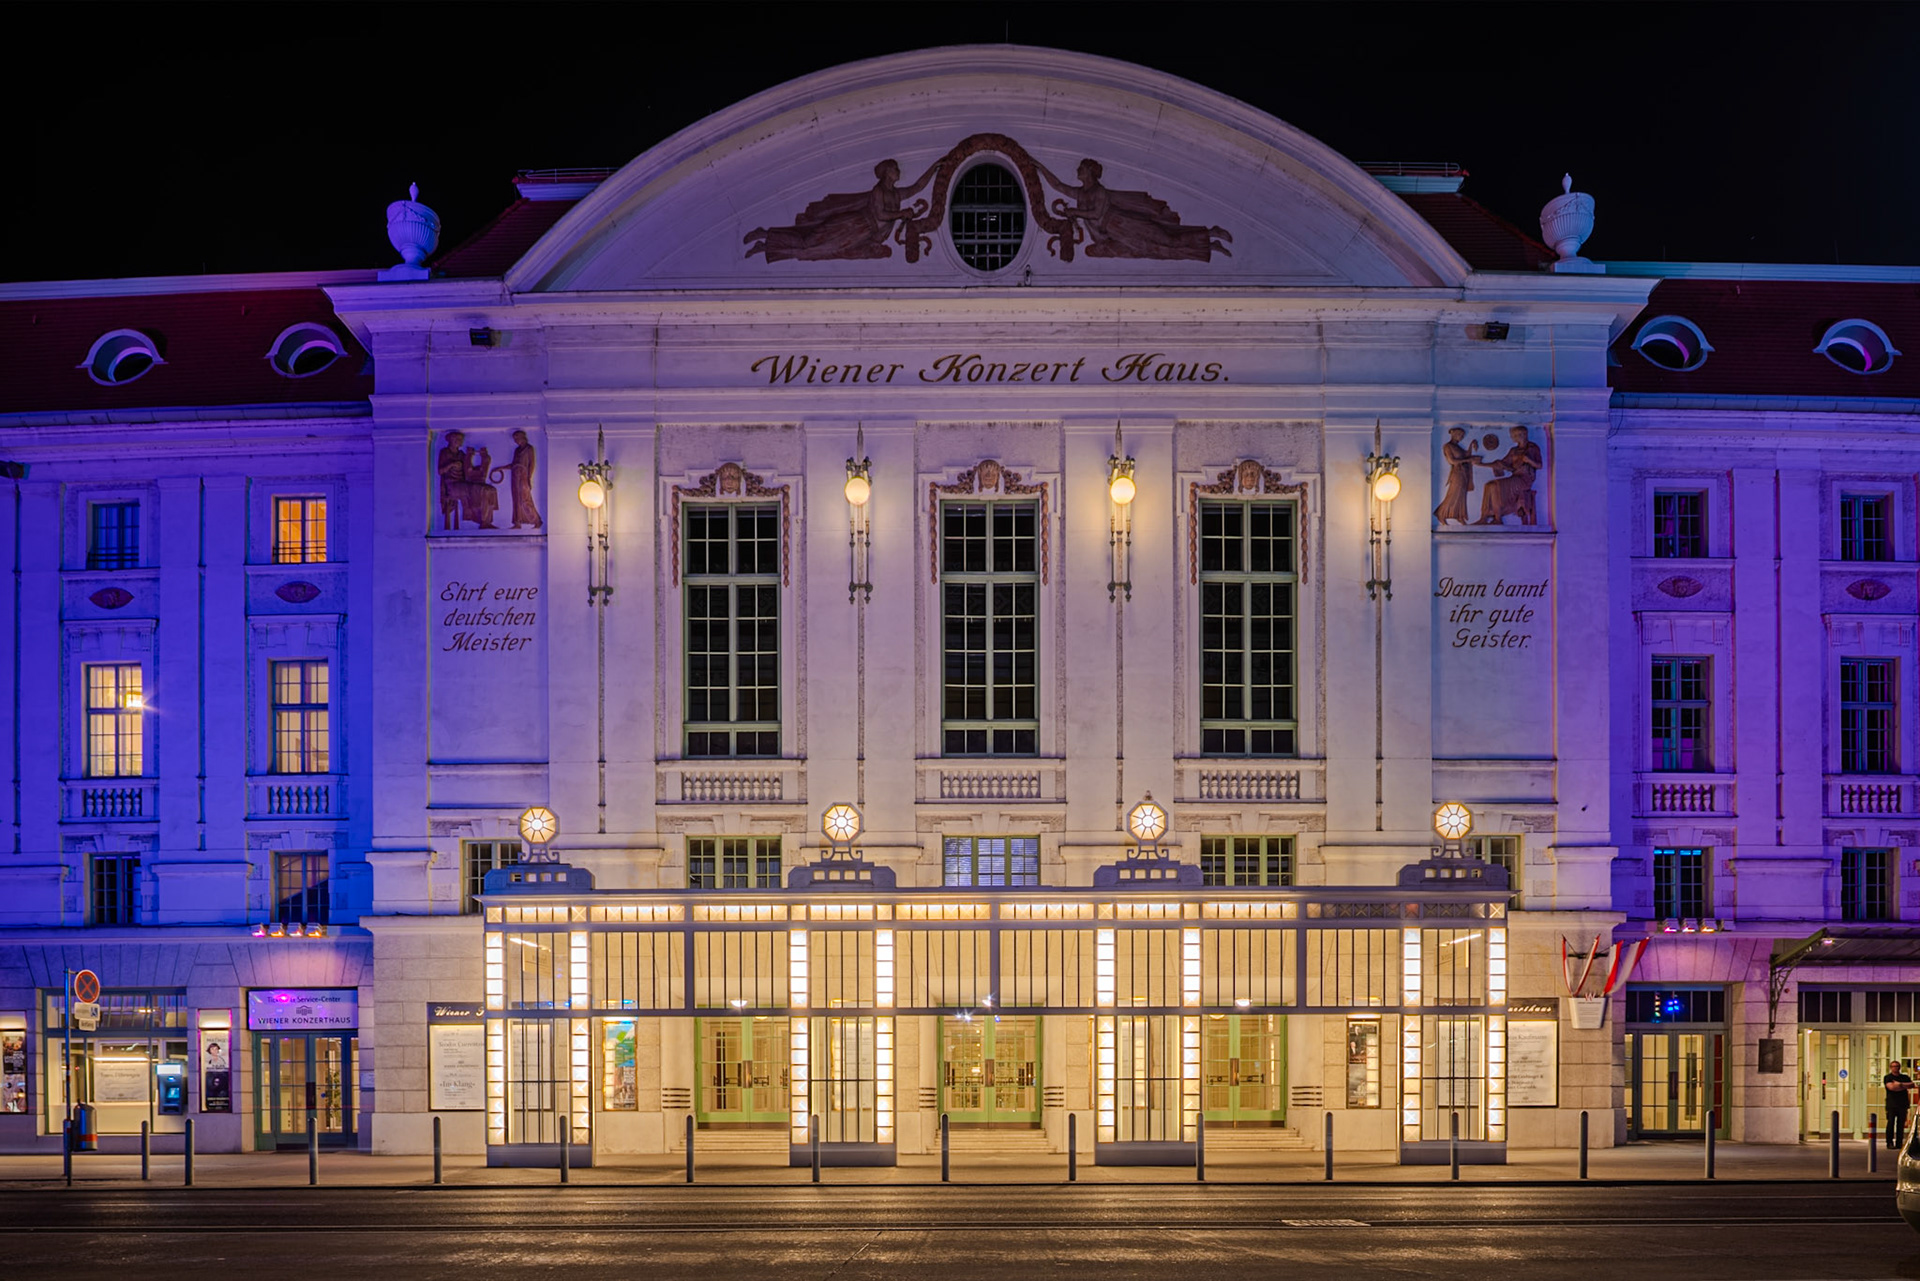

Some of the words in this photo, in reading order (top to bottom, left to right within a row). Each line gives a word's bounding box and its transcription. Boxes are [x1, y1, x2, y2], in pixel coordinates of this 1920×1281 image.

[750, 354, 904, 384] Wiener
[918, 353, 1086, 383] Konzert
[1101, 352, 1231, 383] Haus.
[440, 581, 490, 602] Ehrt
[494, 587, 539, 601] eure
[1433, 577, 1488, 598] Dann
[1493, 579, 1549, 598] bannt
[443, 606, 537, 627] deutschen
[1449, 603, 1484, 624] ihr
[1487, 604, 1534, 629] gute
[442, 631, 533, 652] Meister
[1452, 628, 1532, 649] Geister.
